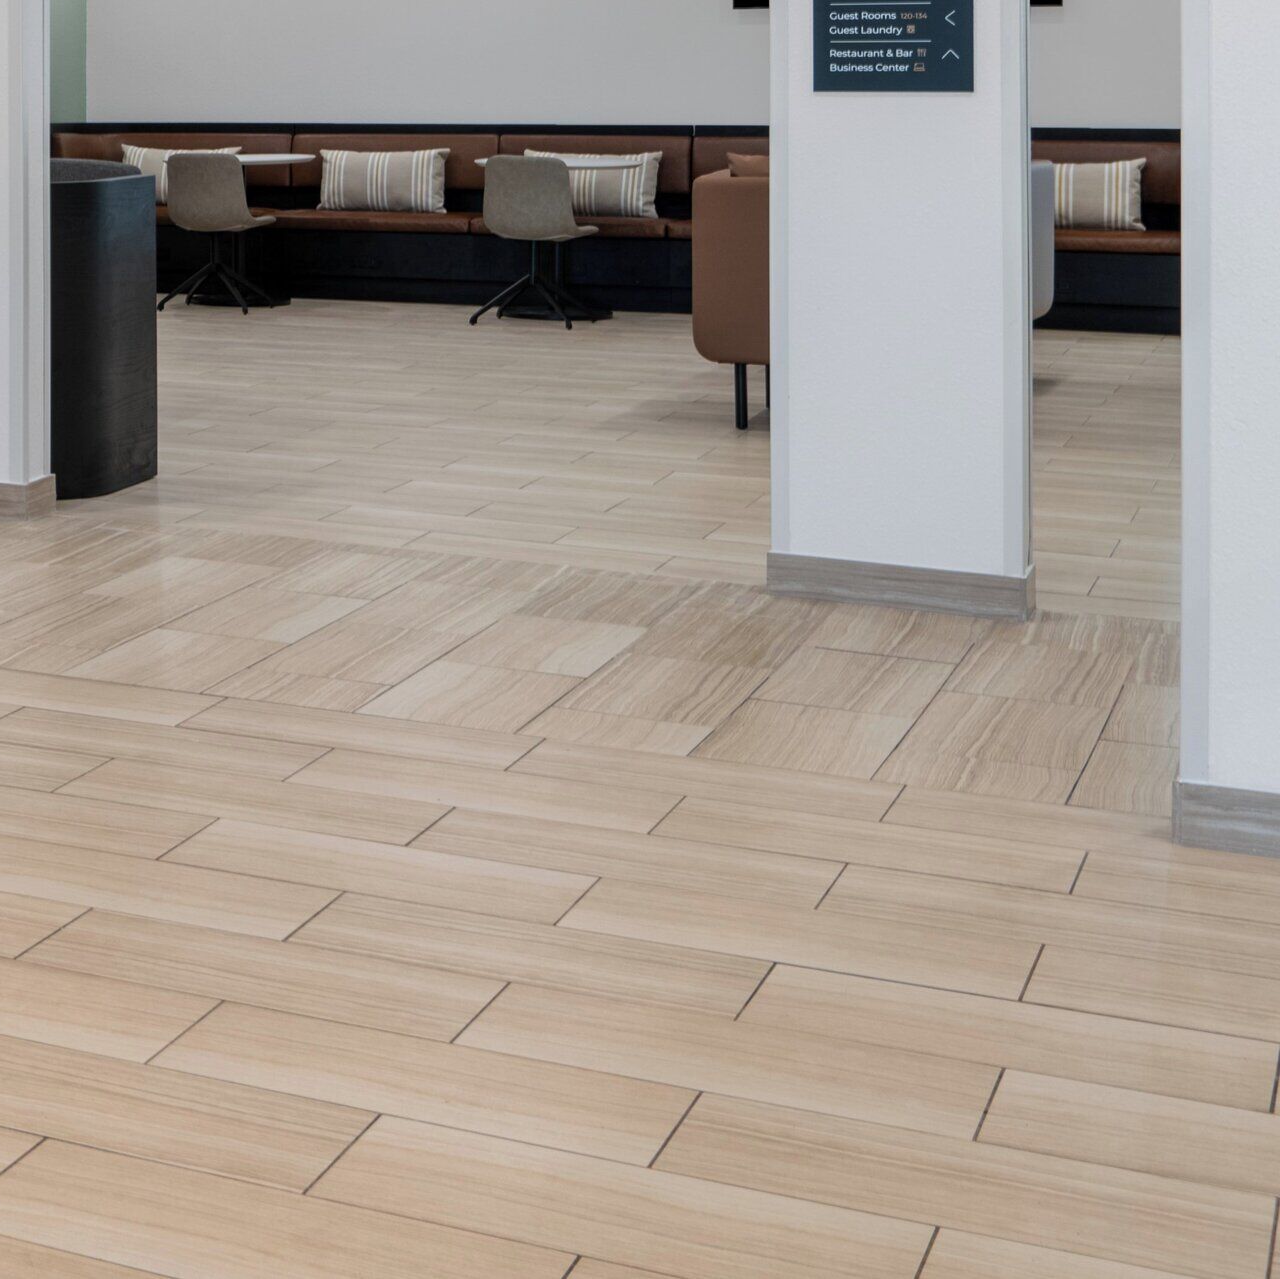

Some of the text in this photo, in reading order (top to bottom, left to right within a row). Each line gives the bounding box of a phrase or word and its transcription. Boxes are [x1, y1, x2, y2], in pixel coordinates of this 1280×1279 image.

[829, 11, 928, 20] Guest Rooms 120-134
[829, 25, 903, 36] Guest Laundry
[829, 49, 913, 58] Restaurant & Bar
[829, 63, 909, 72] Business Center
